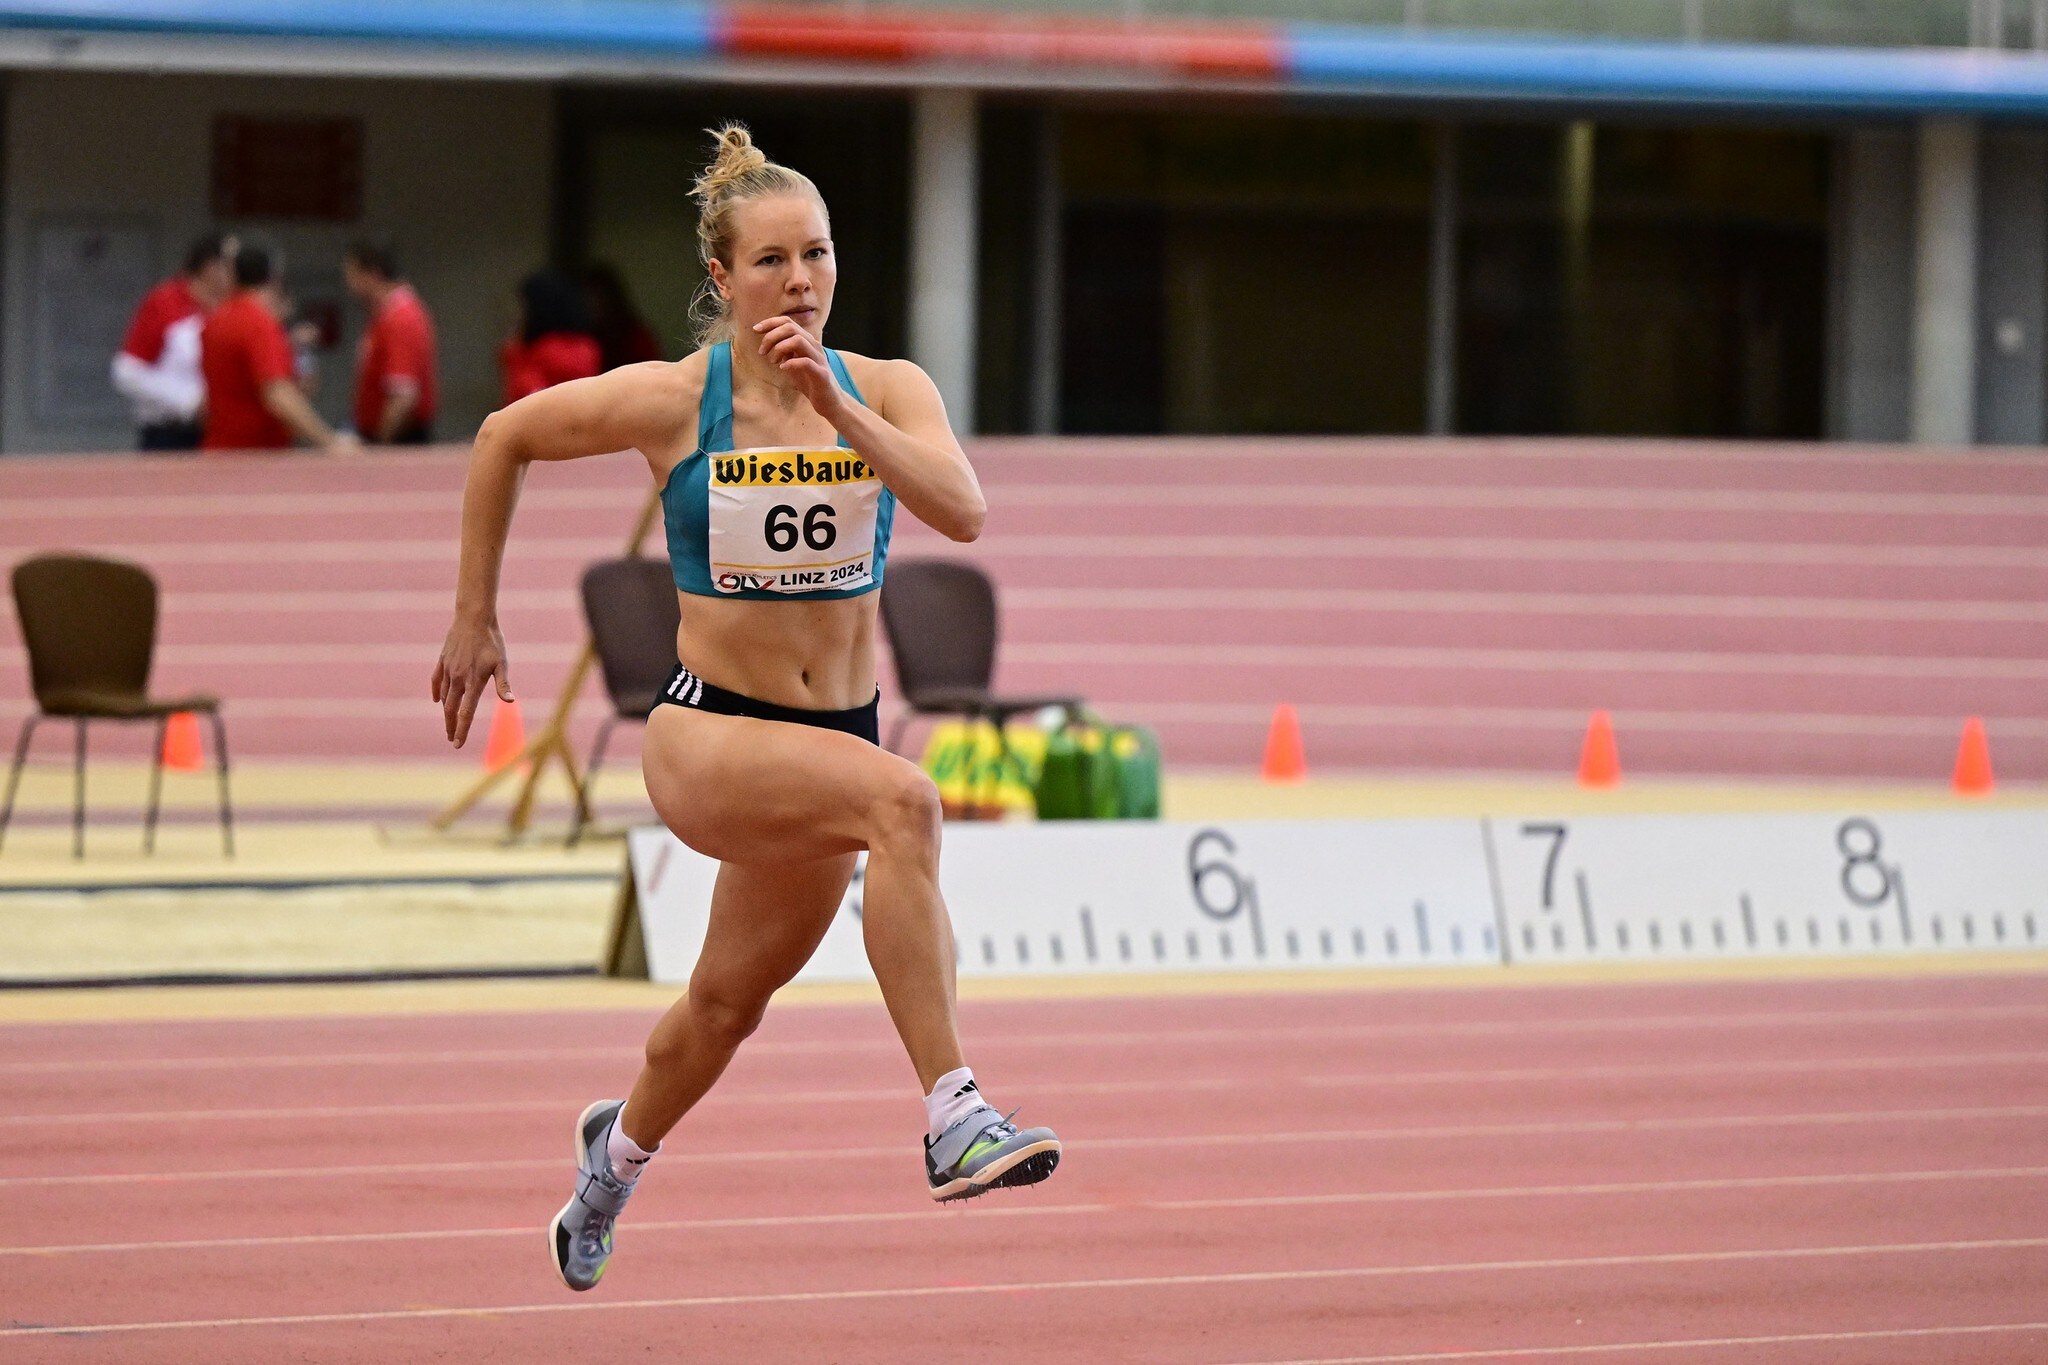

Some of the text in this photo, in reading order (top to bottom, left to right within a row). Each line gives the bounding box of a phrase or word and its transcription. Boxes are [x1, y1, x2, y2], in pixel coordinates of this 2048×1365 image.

[764, 503, 837, 553] 66
[780, 572, 826, 586] LINZ
[830, 561, 864, 582] 2024
[1186, 827, 1243, 920] 6
[1519, 822, 1568, 910] 7
[1836, 816, 1891, 908] 8
